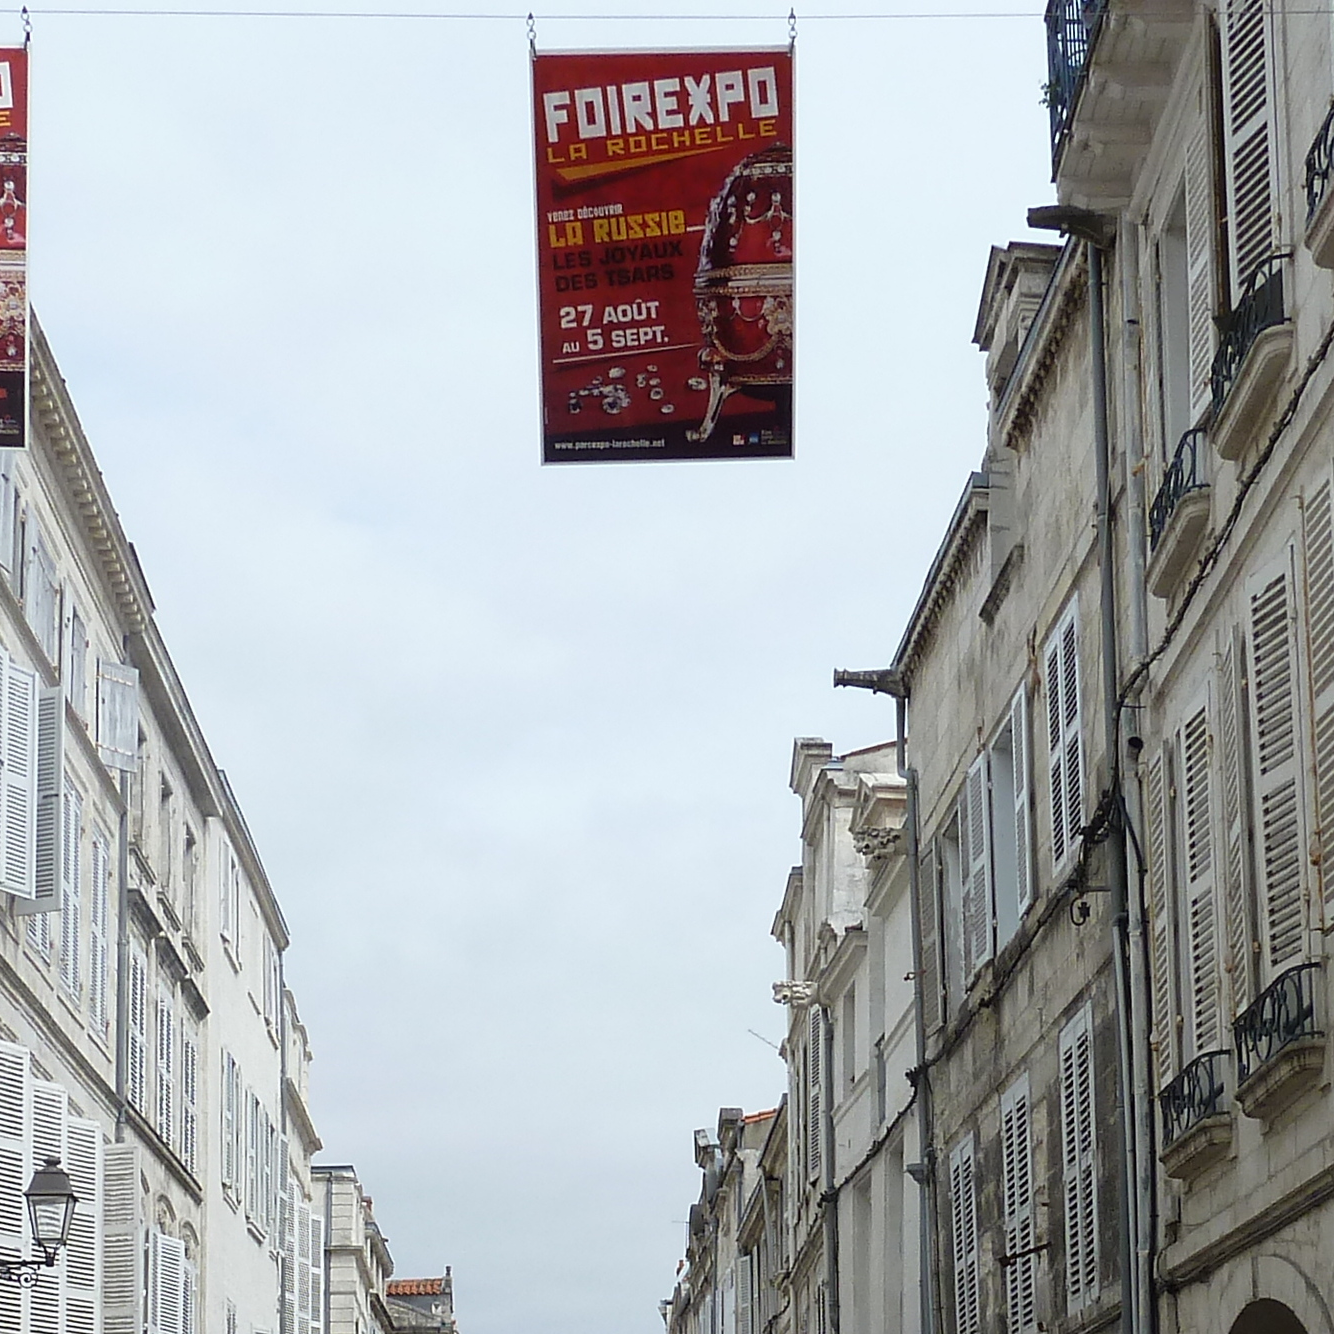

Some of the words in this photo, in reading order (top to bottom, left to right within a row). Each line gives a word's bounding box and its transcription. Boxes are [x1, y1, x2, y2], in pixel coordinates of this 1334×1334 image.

[543, 66, 779, 143] FOIREXPO
[547, 143, 587, 163] LA
[606, 119, 778, 156] ROCHELLE
[549, 221, 584, 248] LA
[593, 210, 686, 243] RUSSIE
[553, 250, 593, 270] LES
[599, 240, 683, 266] JOYAUX
[555, 272, 599, 293] DES
[605, 263, 675, 287] TSARS
[559, 304, 593, 329] 27
[602, 298, 659, 325] AOÛT
[562, 341, 580, 354] AU
[587, 328, 604, 350] 5
[611, 325, 669, 348] SEPT.
